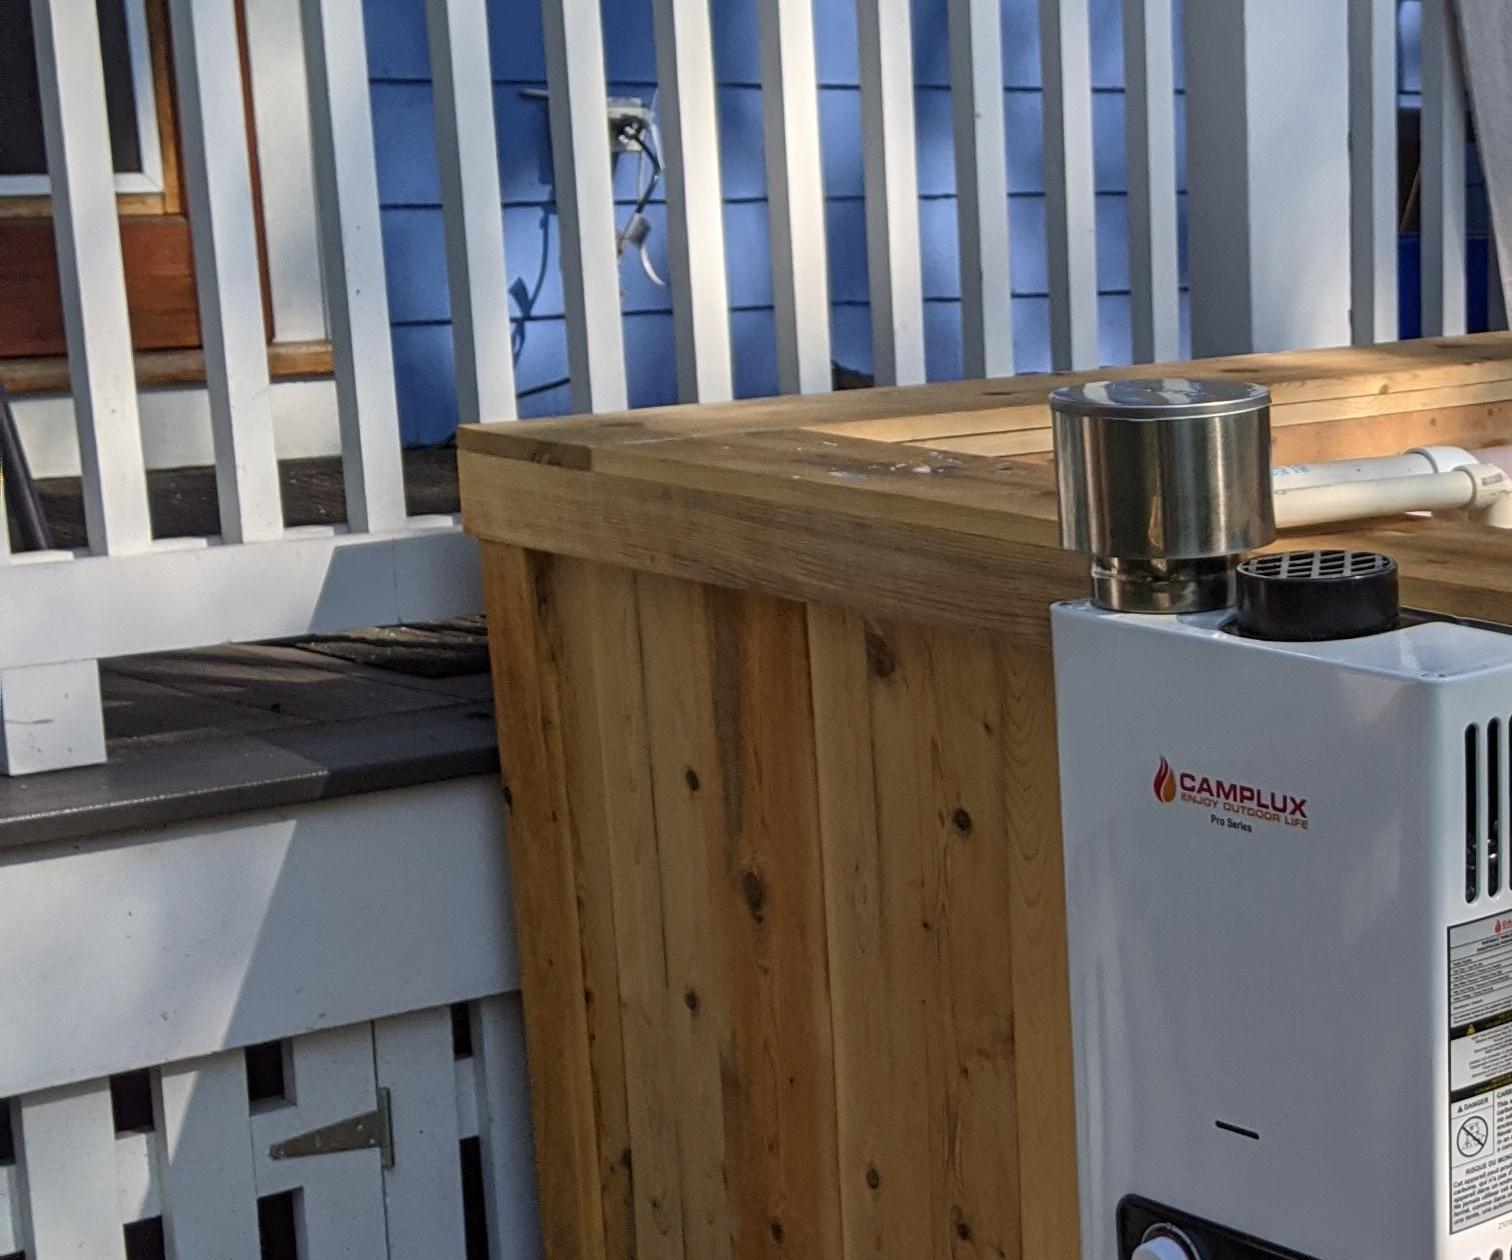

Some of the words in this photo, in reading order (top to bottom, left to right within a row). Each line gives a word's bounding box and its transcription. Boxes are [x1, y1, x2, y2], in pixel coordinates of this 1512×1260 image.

[1180, 772, 1307, 818] CAMPLUX
[1180, 791, 1219, 808] ENJOY
[1223, 802, 1281, 822] OUTDOOR
[1284, 816, 1308, 830] LIFE
[1210, 814, 1225, 826] Pro
[1227, 817, 1252, 832] Series
